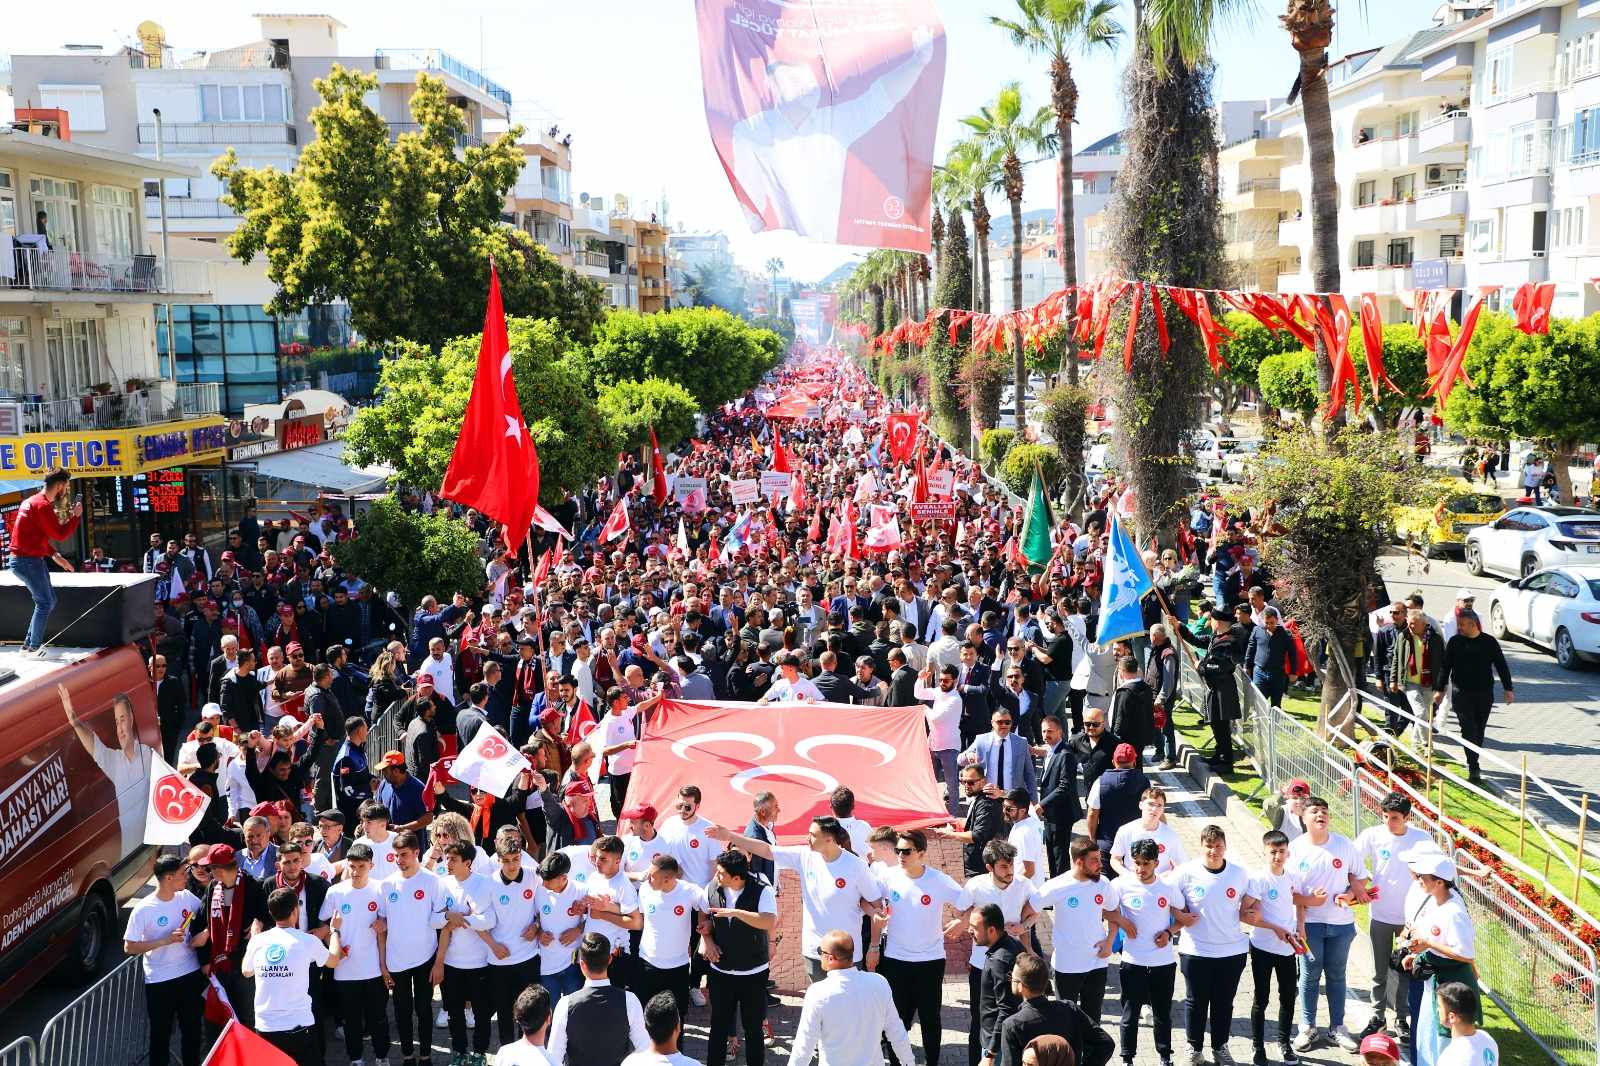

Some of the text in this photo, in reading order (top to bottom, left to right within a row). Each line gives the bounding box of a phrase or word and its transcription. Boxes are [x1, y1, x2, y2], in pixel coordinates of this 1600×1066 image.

[23, 440, 122, 470] OFFICE
[42, 776, 69, 817] VAR!
[0, 882, 75, 952] ADEM MURAT YÜCEL
[2, 907, 22, 929] Daha
[22, 889, 42, 917] güçlü
